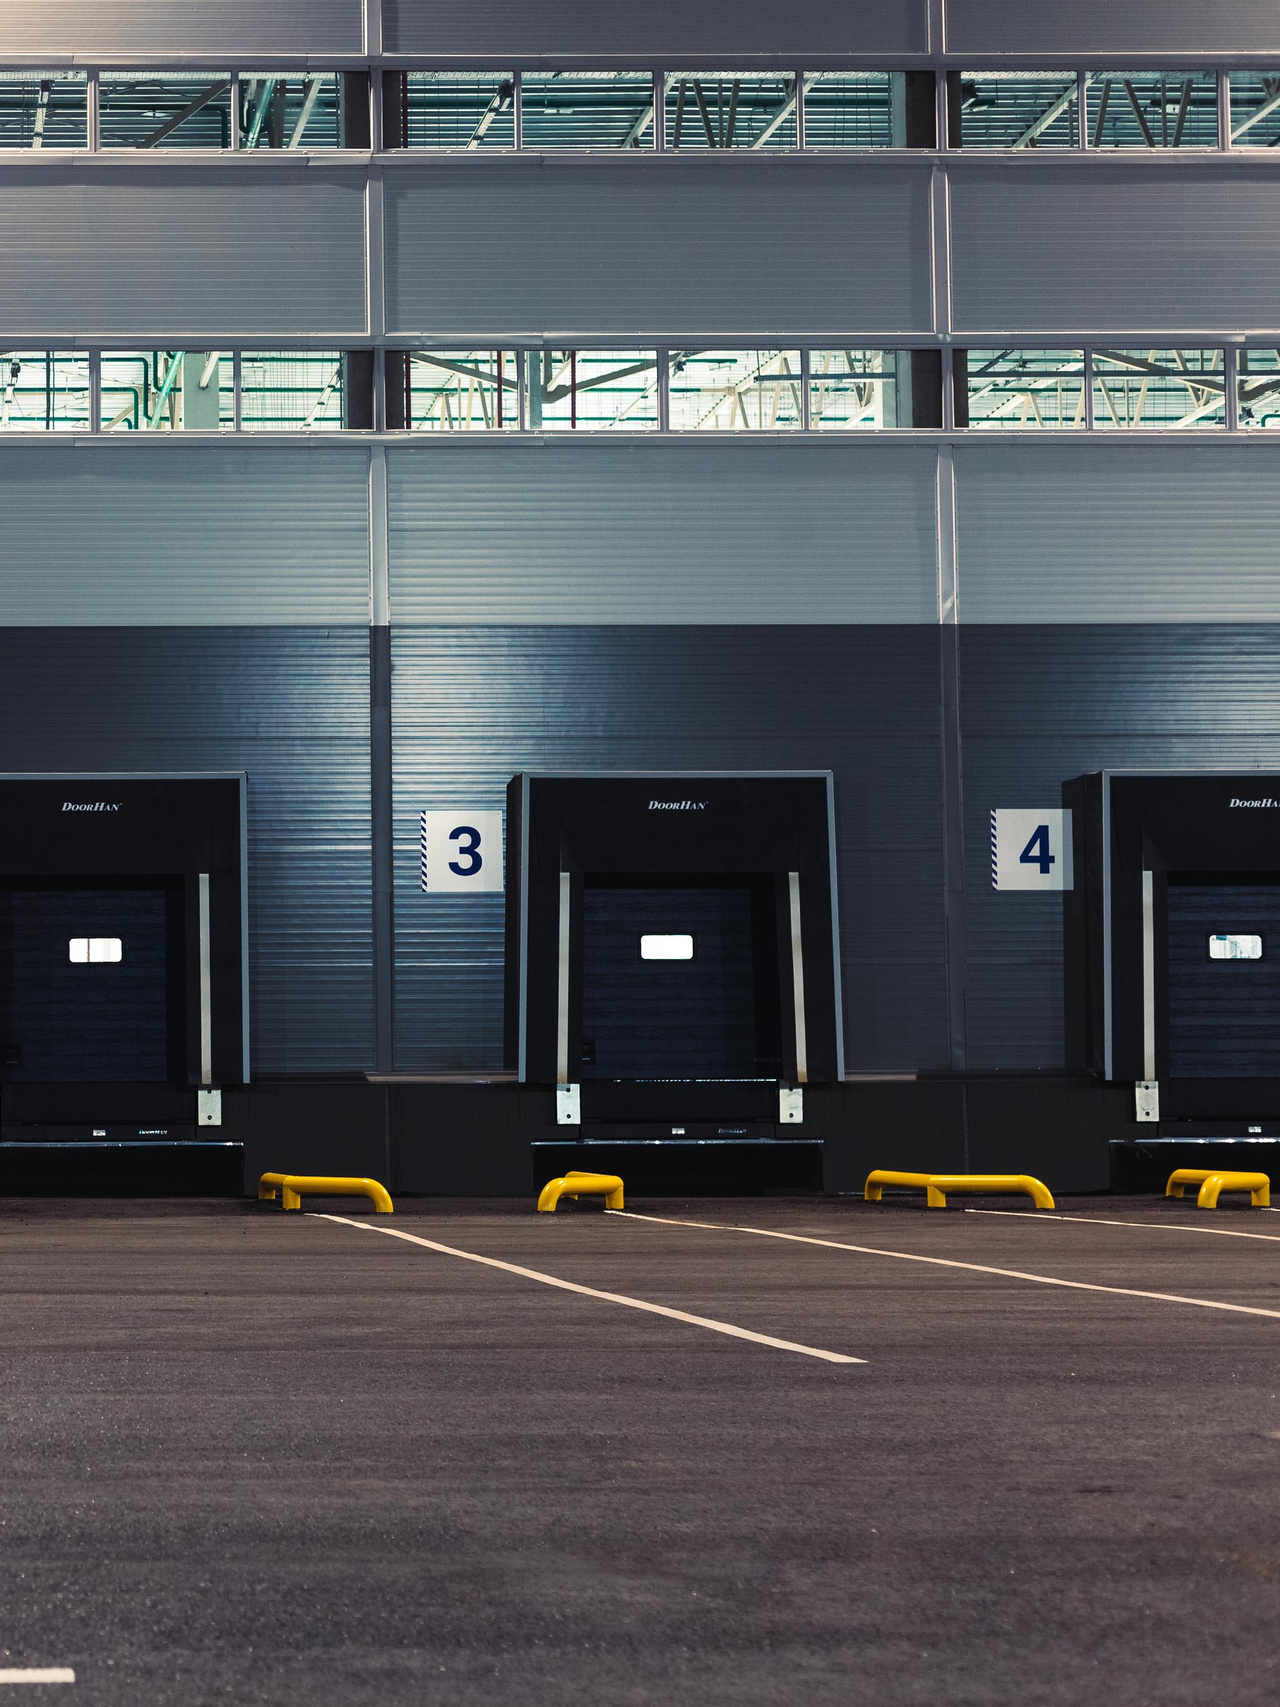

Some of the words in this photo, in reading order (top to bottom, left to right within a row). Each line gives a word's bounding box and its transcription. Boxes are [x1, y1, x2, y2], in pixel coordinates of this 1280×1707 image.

[1229, 798, 1280, 808] DOORHA
[448, 826, 483, 876] 3
[1019, 825, 1055, 874] 4
